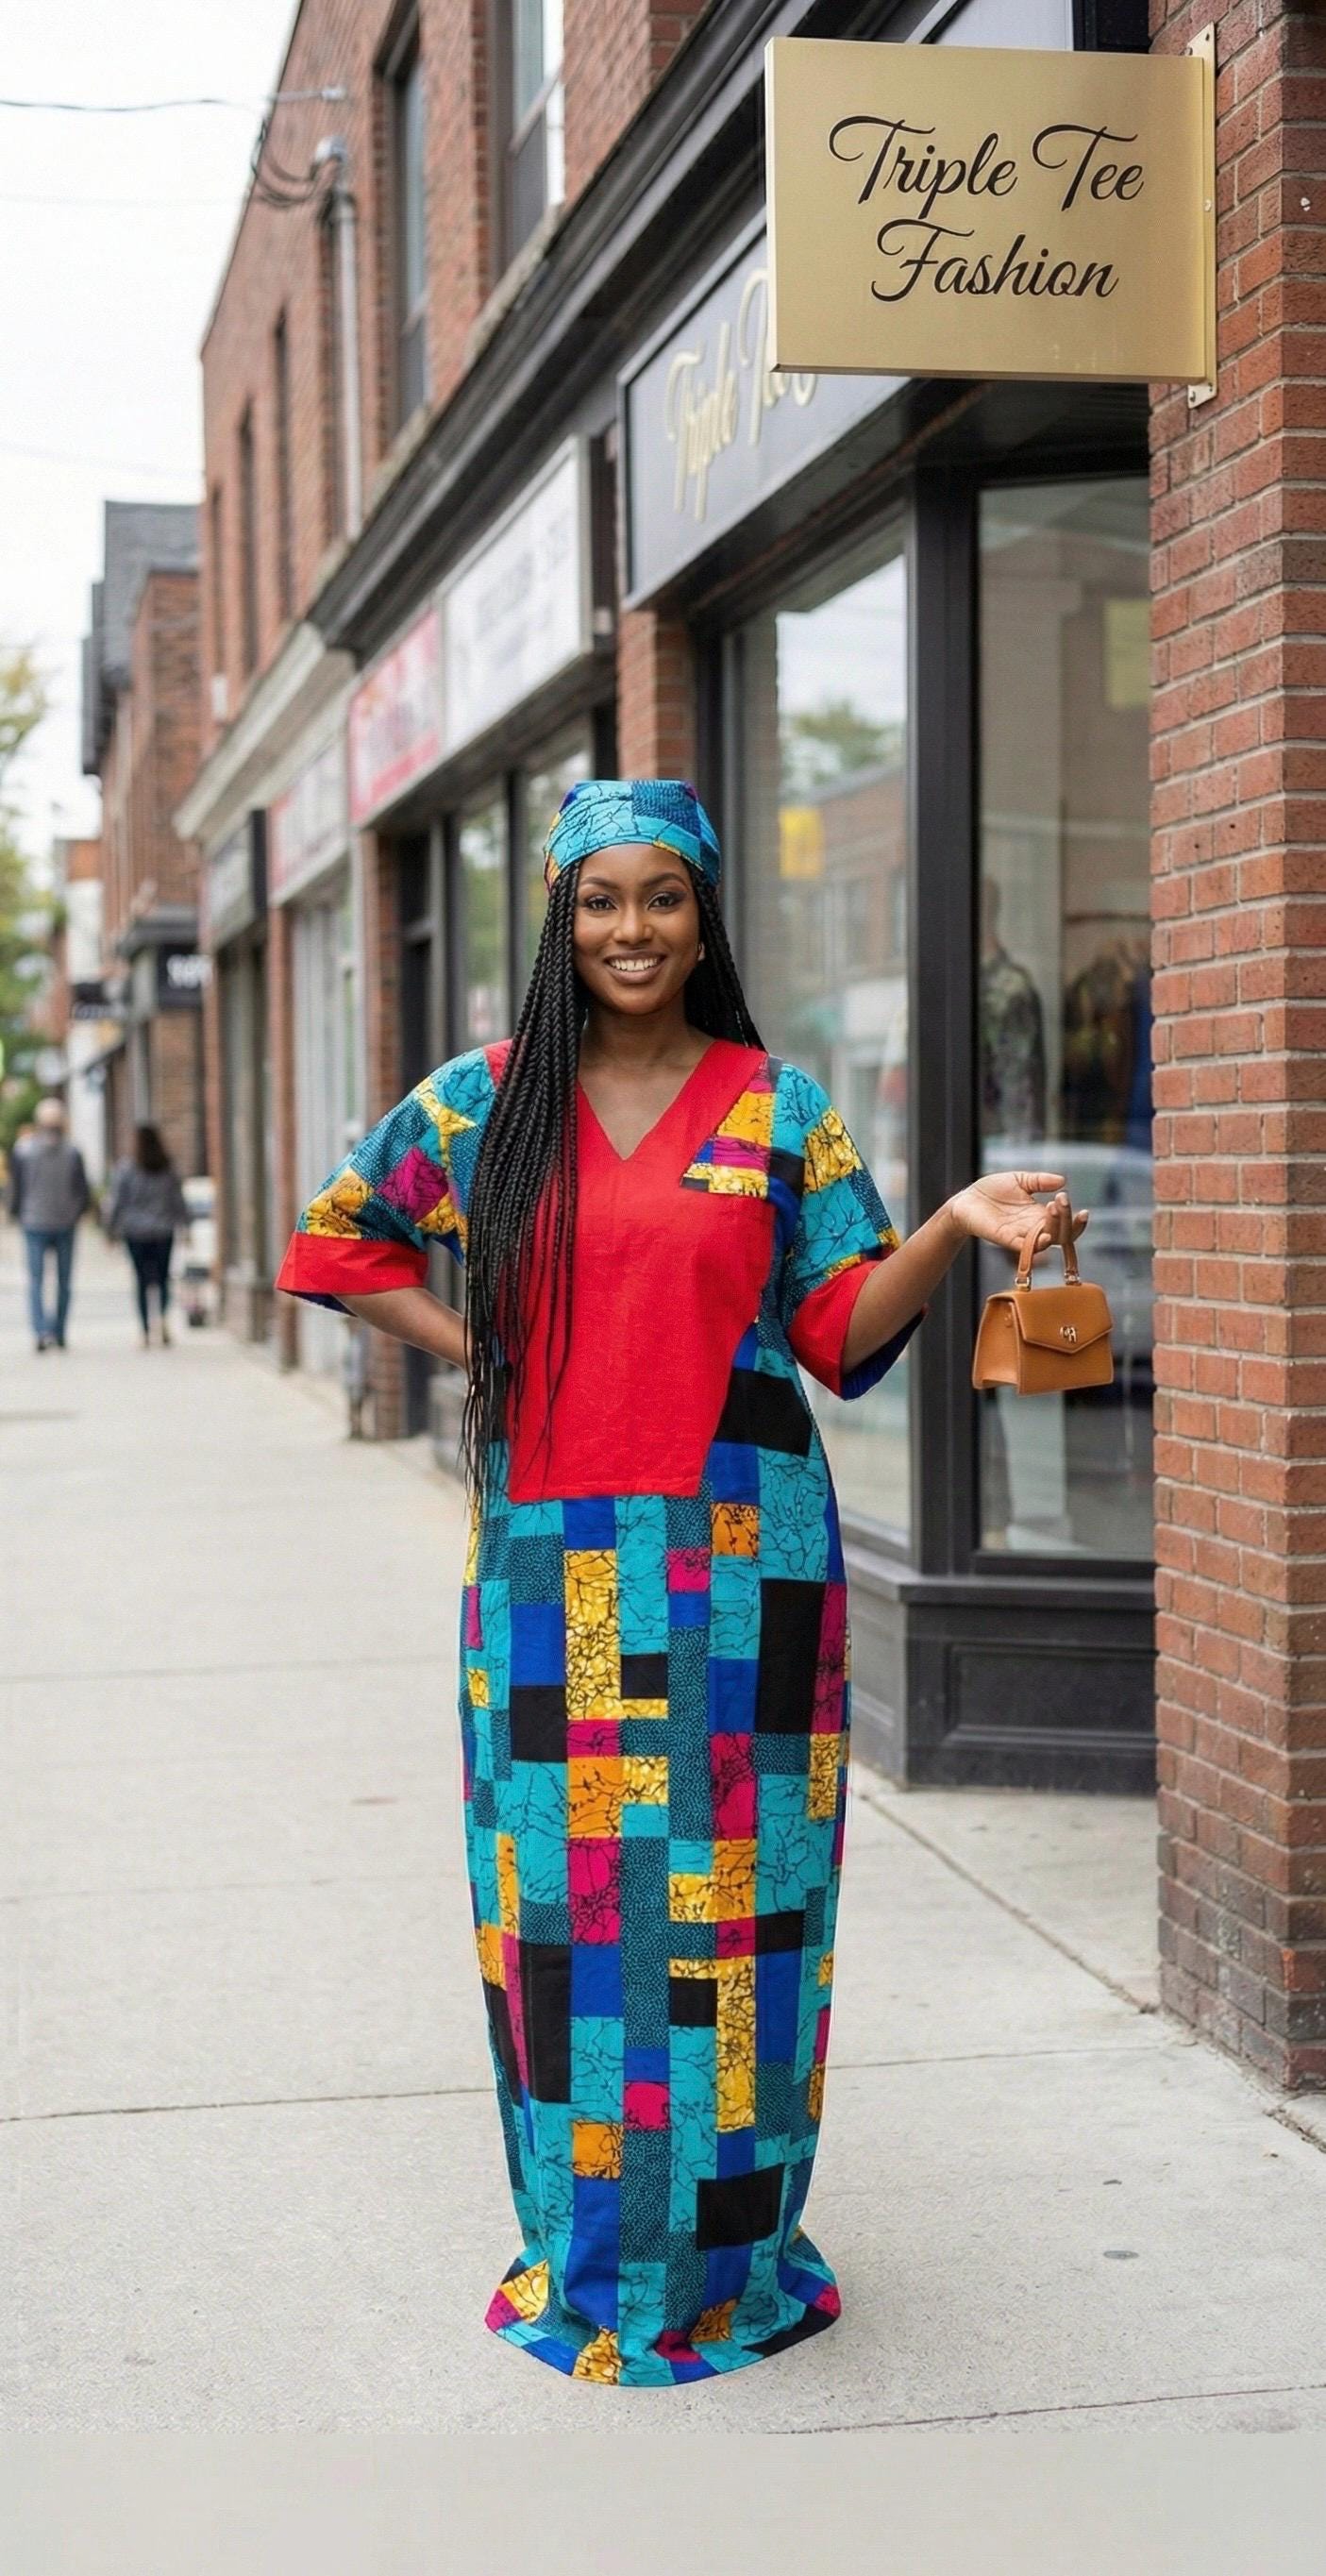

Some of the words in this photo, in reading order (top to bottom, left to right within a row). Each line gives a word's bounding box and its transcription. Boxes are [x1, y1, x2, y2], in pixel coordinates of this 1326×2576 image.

[829, 115, 1017, 219] Triple
[1032, 124, 1145, 211] Tee
[871, 219, 1119, 302] Fashion
